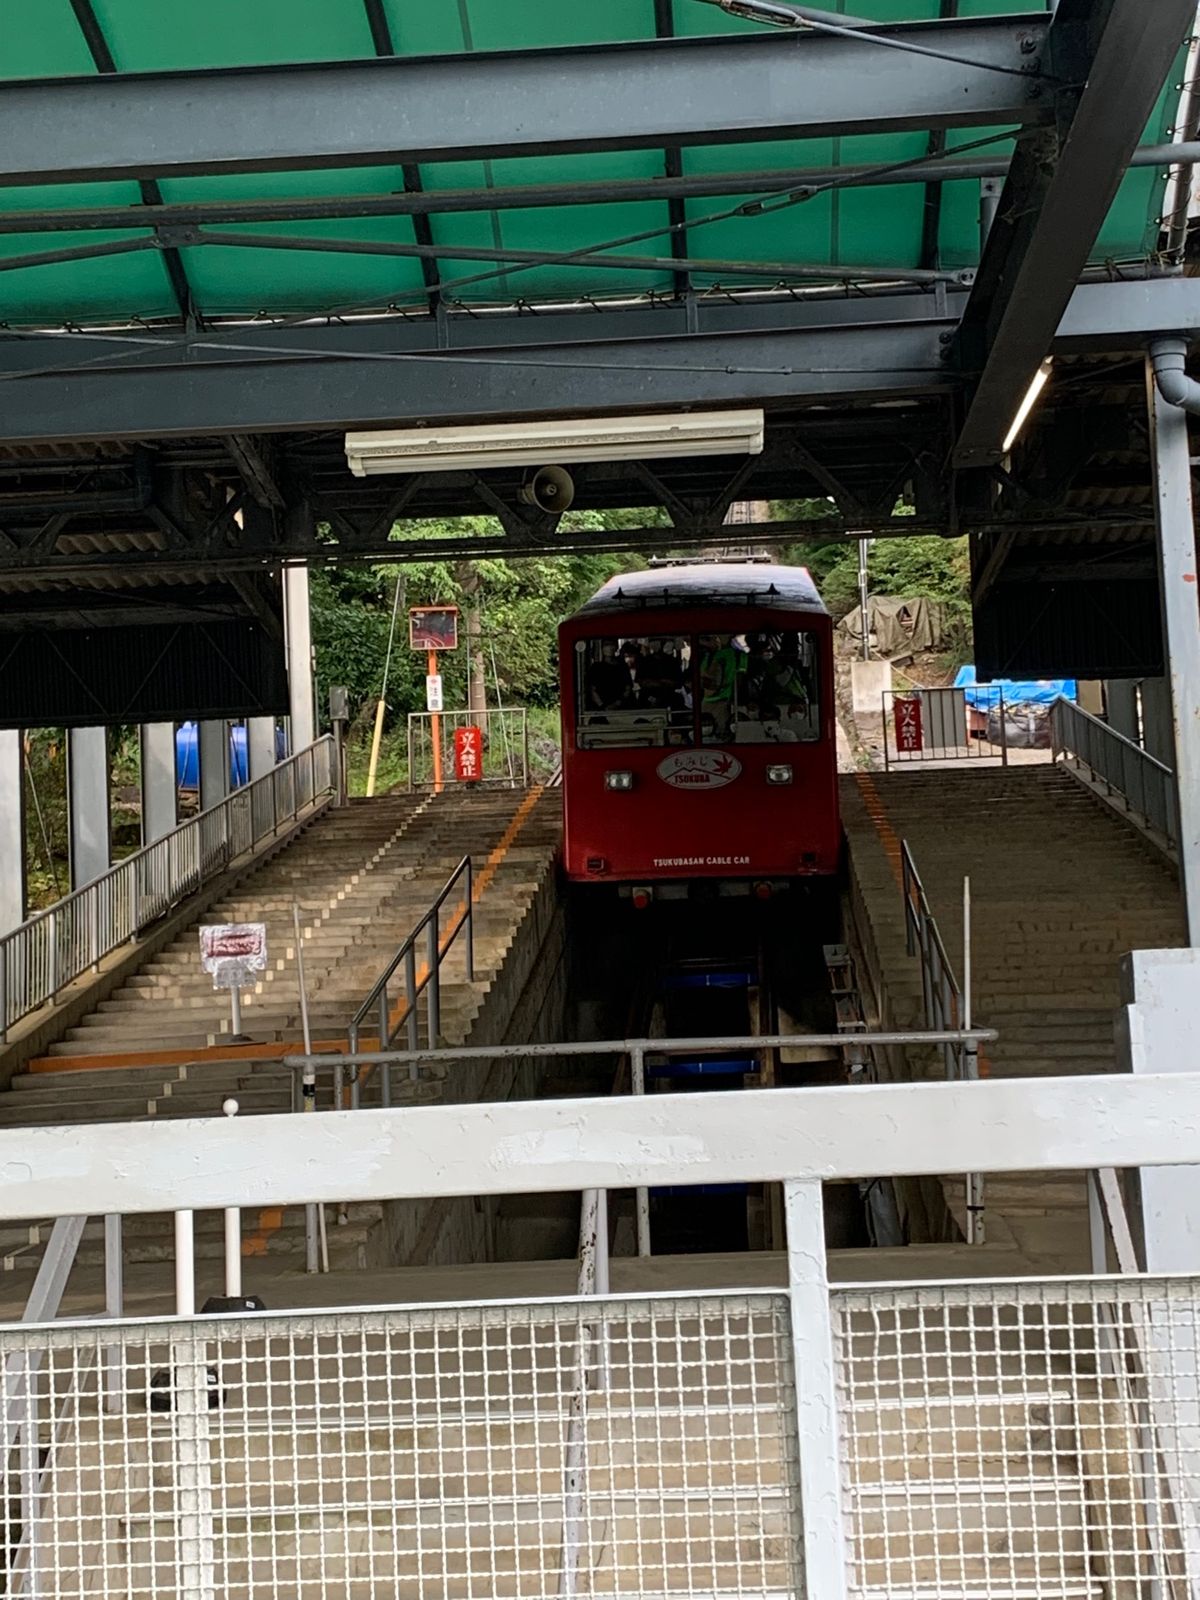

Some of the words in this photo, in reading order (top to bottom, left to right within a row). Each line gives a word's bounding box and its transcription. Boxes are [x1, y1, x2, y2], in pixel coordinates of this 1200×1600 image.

[900, 703, 917, 748] 立入禁止
[460, 732, 477, 777] 立入禁止
[674, 756, 709, 768] もみじ
[674, 774, 710, 784] TSUKUBA
[653, 857, 704, 867] TSUKUBASAN
[706, 856, 732, 865] CABLE
[733, 856, 750, 865] CAR
